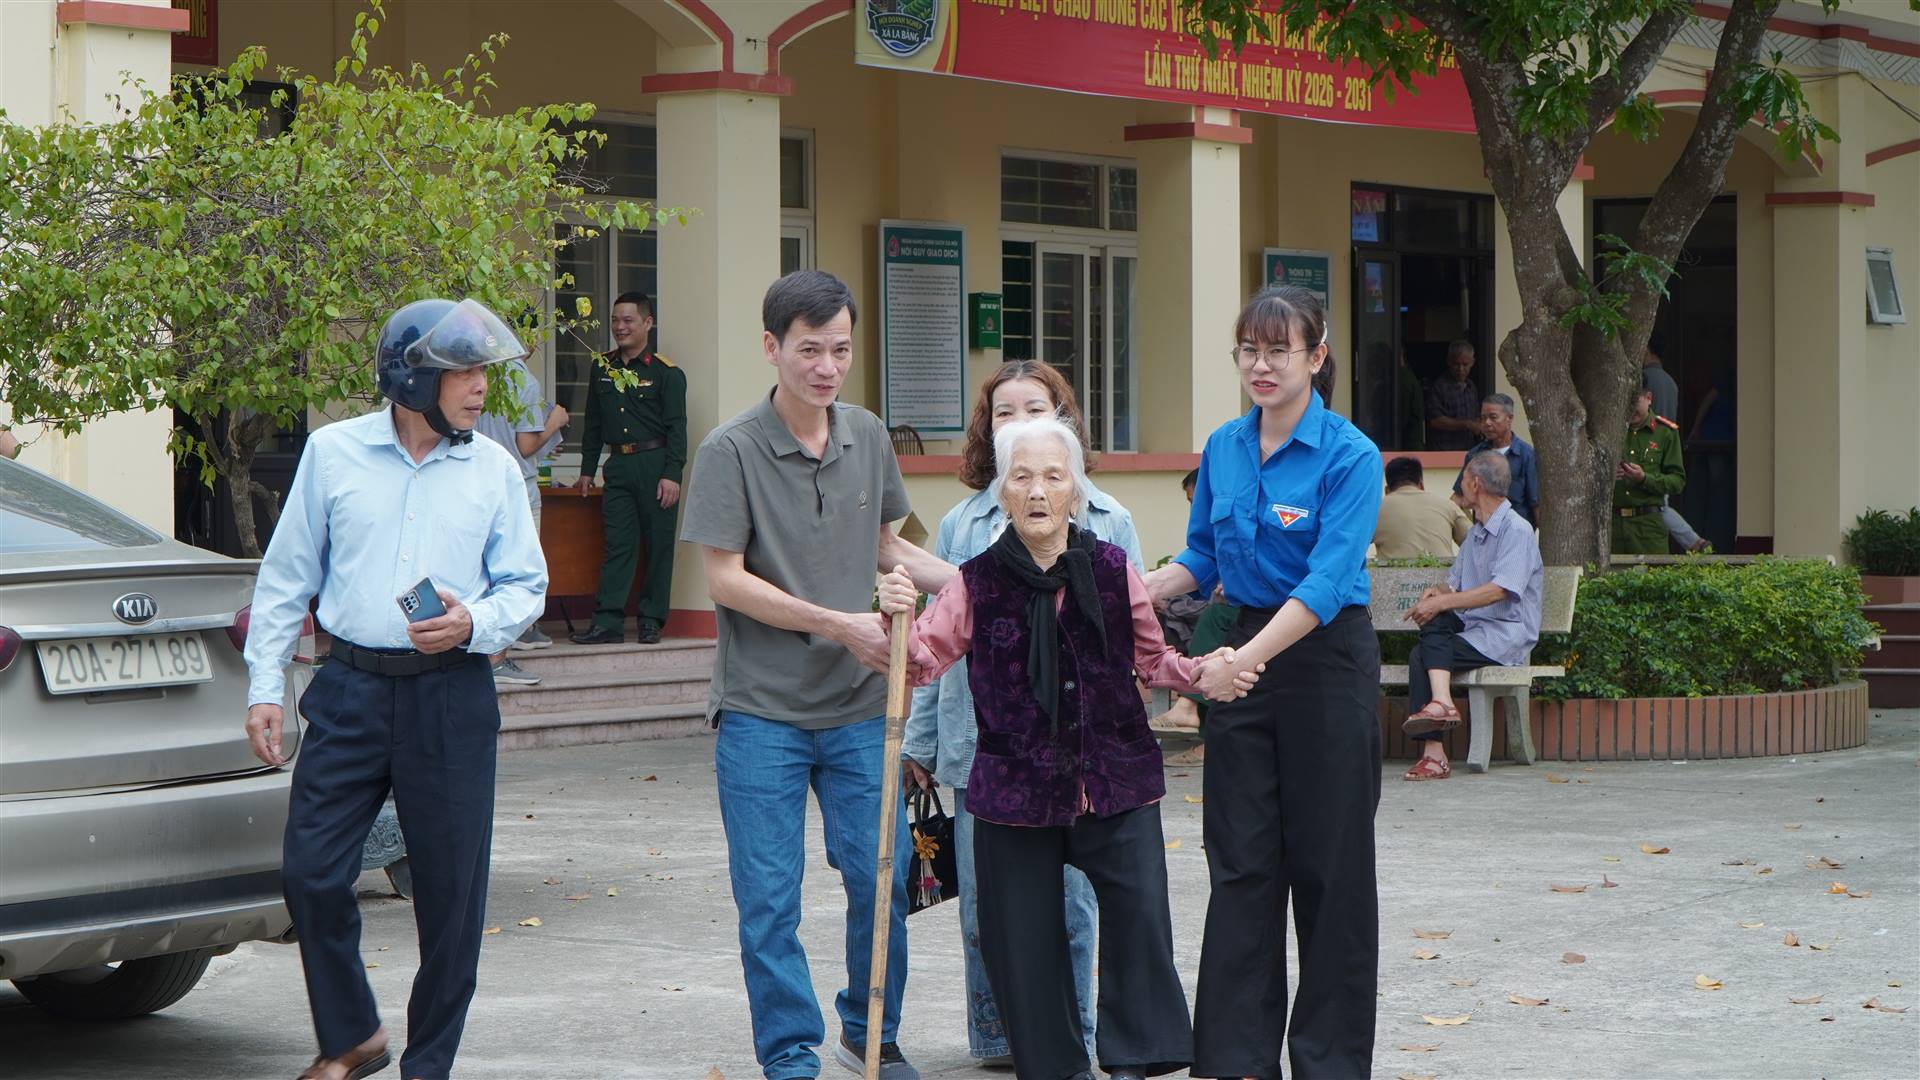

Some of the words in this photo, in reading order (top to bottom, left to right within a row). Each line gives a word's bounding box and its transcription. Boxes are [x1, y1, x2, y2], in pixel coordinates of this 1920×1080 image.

[892, 29, 900, 39] LA
[1144, 39, 1171, 88] LẦN
[1174, 48, 1201, 91] THỨ
[1203, 48, 1239, 100] NHẤT,
[1242, 58, 1283, 108] NHIỆM
[1286, 63, 1302, 104] KỲ
[1304, 71, 1334, 108] 2026
[1344, 76, 1372, 112] 2031
[913, 247, 926, 257] QUY
[927, 248, 943, 257] GIAO
[122, 599, 154, 618] KIA
[47, 636, 205, 685] 20A-271.89
